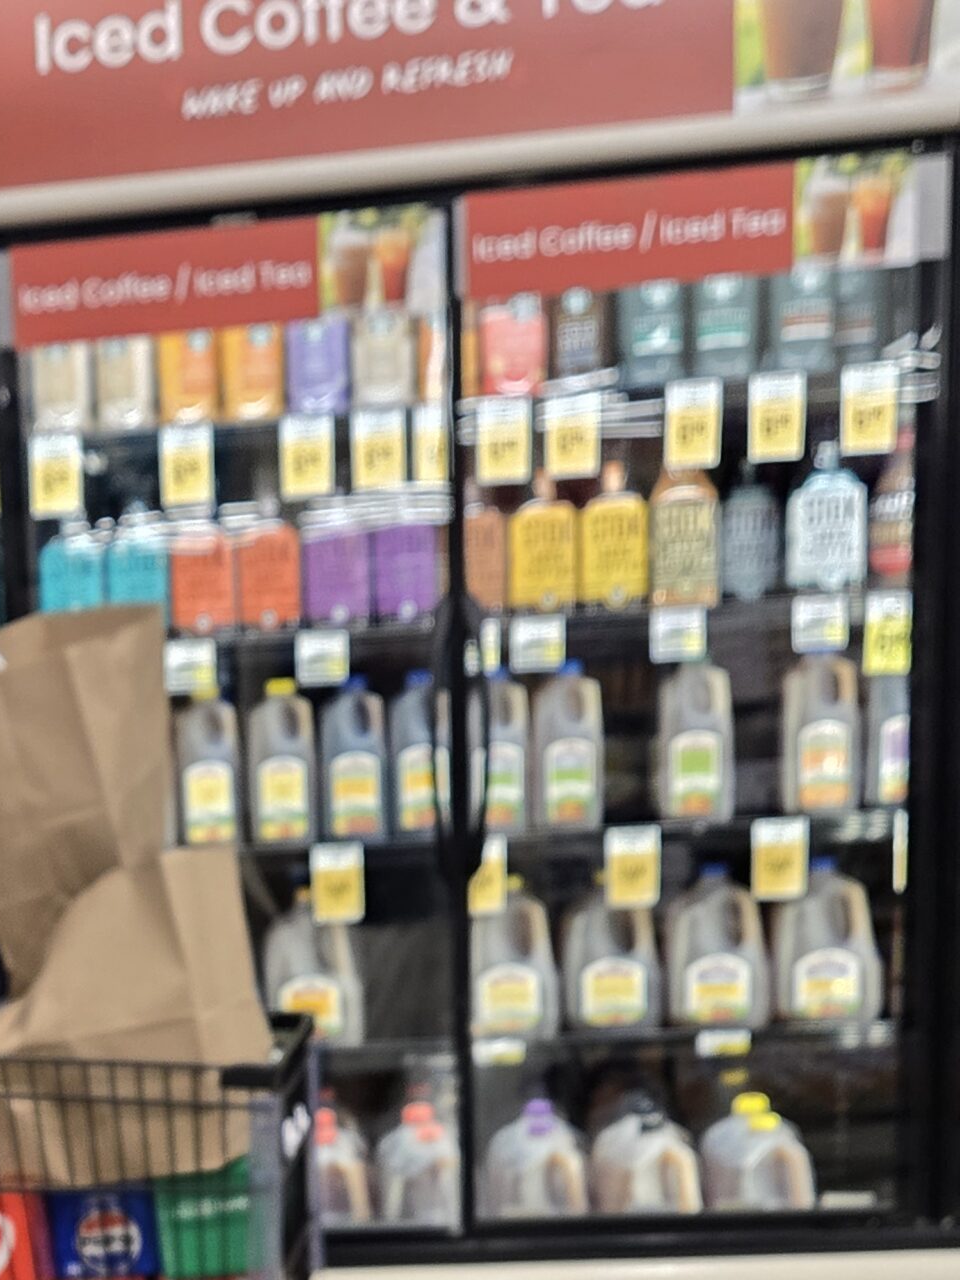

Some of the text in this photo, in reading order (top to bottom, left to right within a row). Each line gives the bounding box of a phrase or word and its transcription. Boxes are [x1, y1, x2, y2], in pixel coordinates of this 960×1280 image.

[34, 0, 184, 76] Iced
[269, 75, 307, 109] UP
[314, 66, 374, 104] AND
[381, 49, 514, 94] REFRESH
[474, 228, 536, 263] Iced
[540, 221, 637, 256] Coffee
[661, 208, 725, 245] Iced
[730, 207, 785, 239] Tea
[19, 279, 79, 314] Iced
[81, 271, 172, 308] Coffee
[194, 261, 255, 297] Iced
[258, 261, 312, 290] Tea
